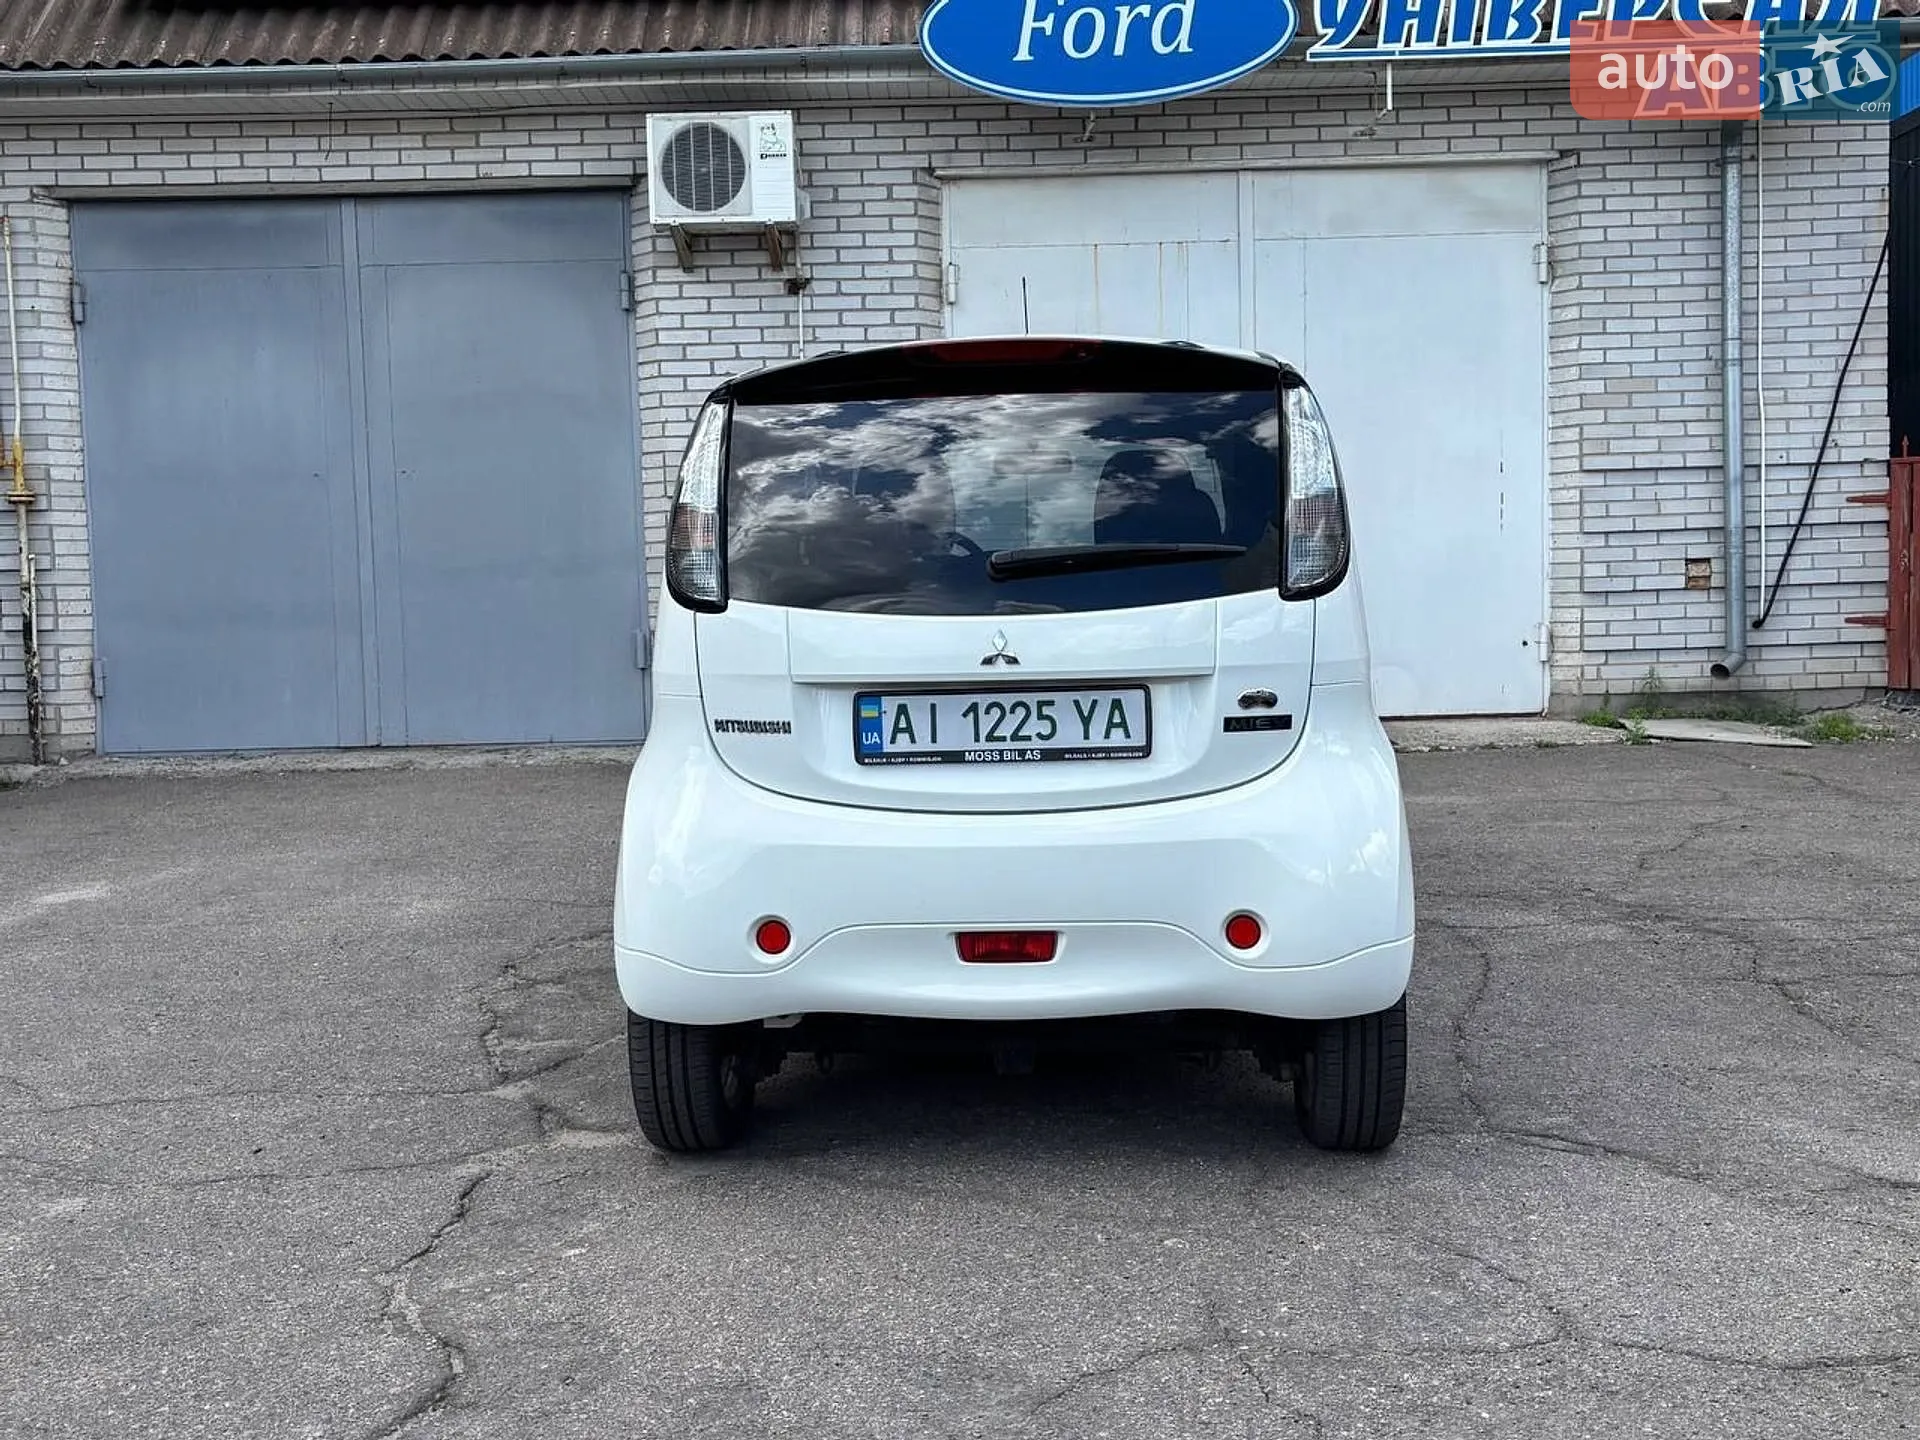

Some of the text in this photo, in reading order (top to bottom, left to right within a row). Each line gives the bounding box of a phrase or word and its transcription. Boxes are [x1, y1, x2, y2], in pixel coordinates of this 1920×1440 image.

[1012, 0, 1194, 61] Ford
[714, 719, 792, 735] MITSUBISHI
[889, 699, 1132, 745] AI 1225 YA
[862, 732, 881, 745] UA
[964, 749, 1041, 762] MOSS BIL AS
